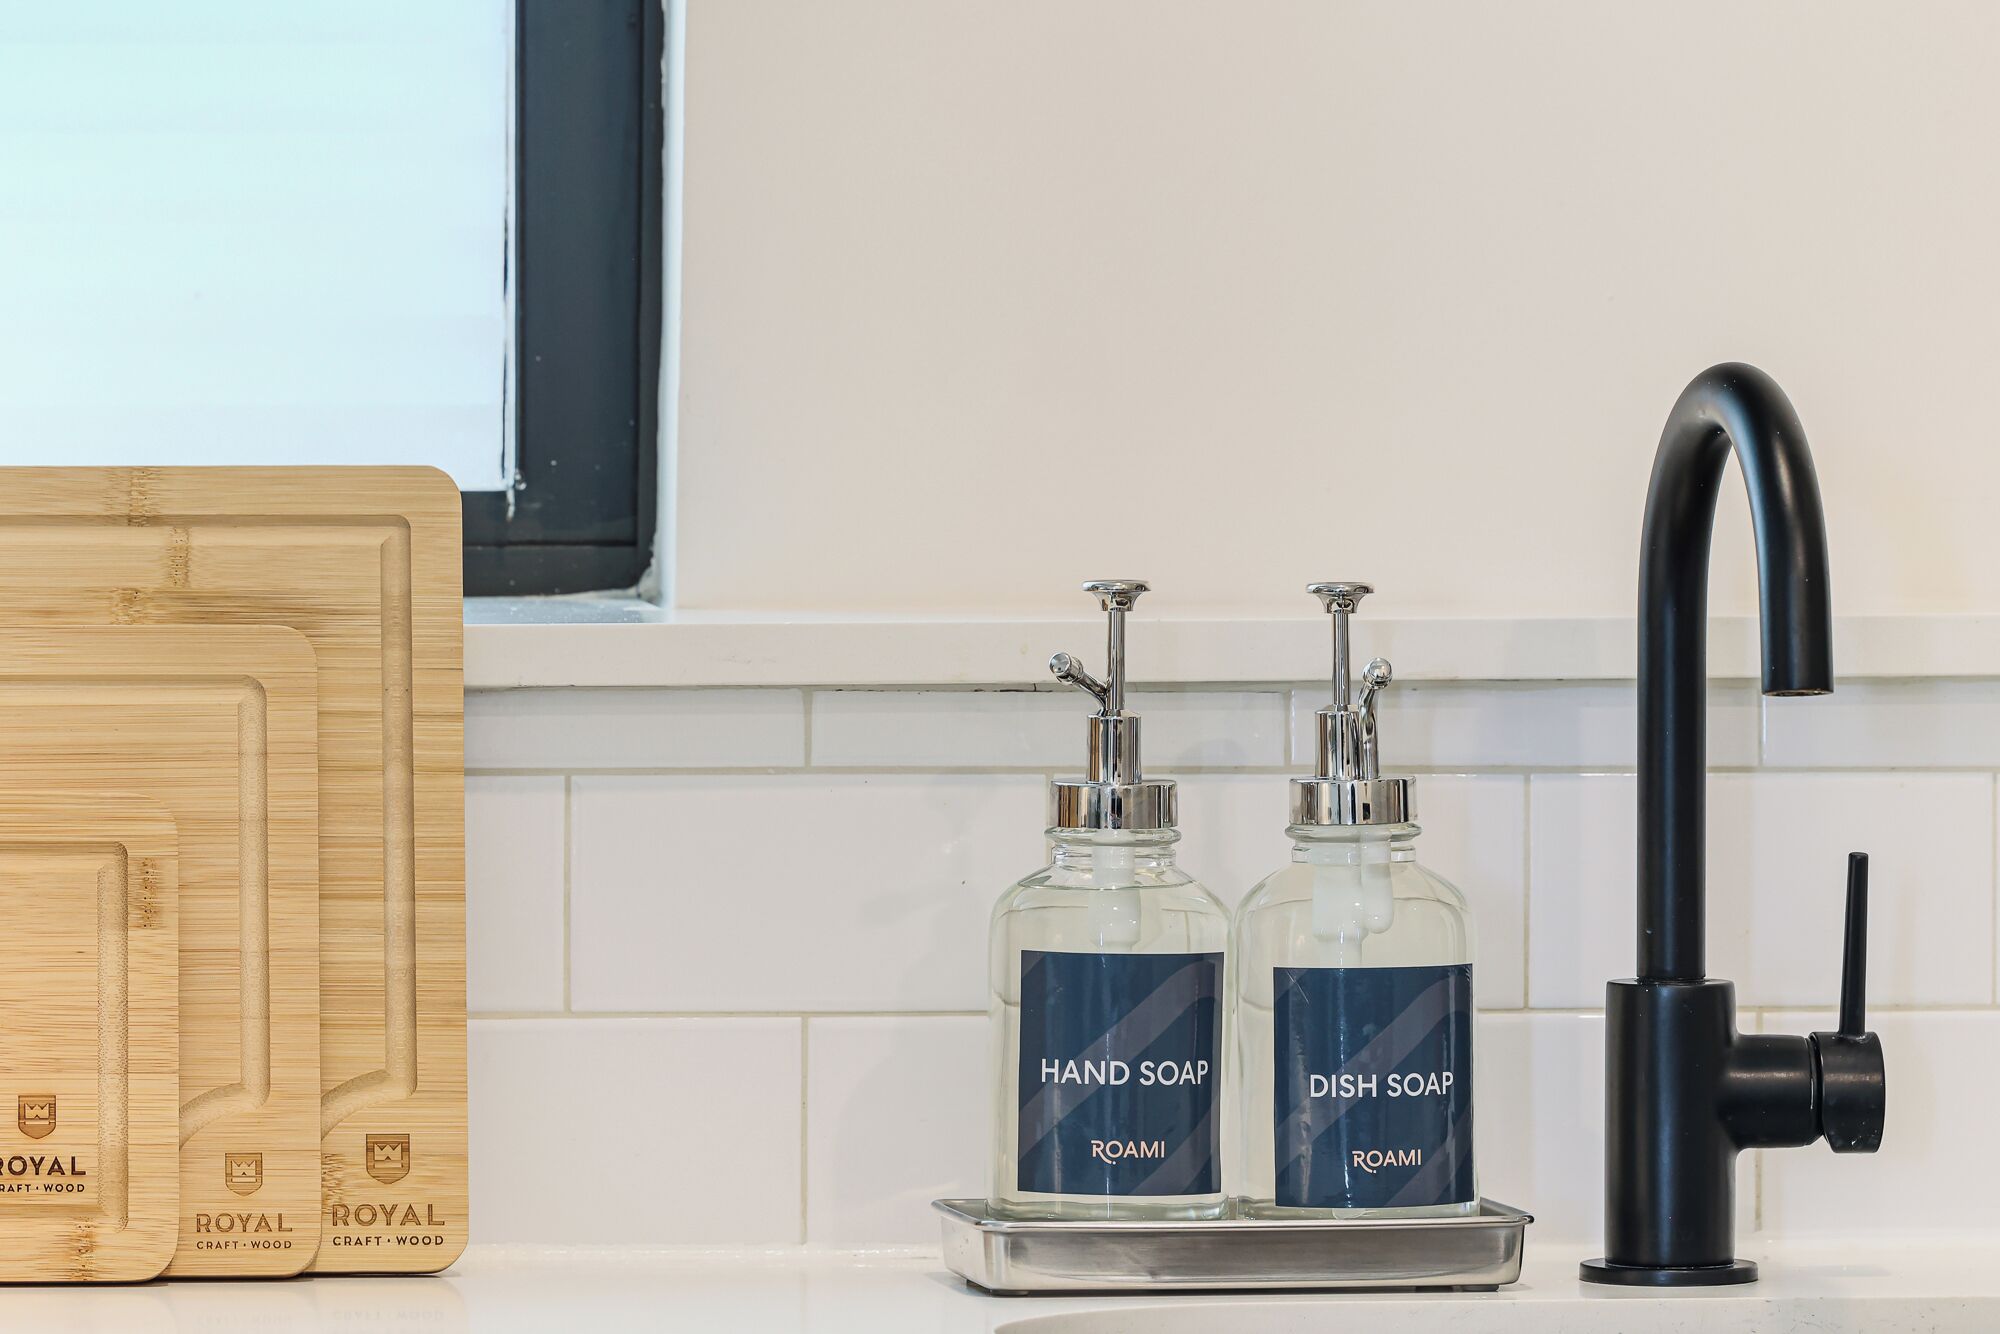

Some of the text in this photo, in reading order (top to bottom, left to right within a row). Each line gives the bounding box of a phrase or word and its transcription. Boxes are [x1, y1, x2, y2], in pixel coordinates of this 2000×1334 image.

[1041, 1058, 1209, 1086] HAND SOAP
[1309, 1071, 1454, 1098] DISH SOAP
[1091, 1140, 1165, 1165] ROAMI
[1352, 1149, 1422, 1173] ROAMI
[0, 1156, 87, 1176] OYAL
[43, 1183, 86, 1193] WOOD
[196, 1212, 293, 1233] ROYAL
[332, 1203, 445, 1227] ROYAL
[196, 1239, 292, 1250] CRAFT WOOD
[332, 1234, 444, 1246] CRAFT WOOD
